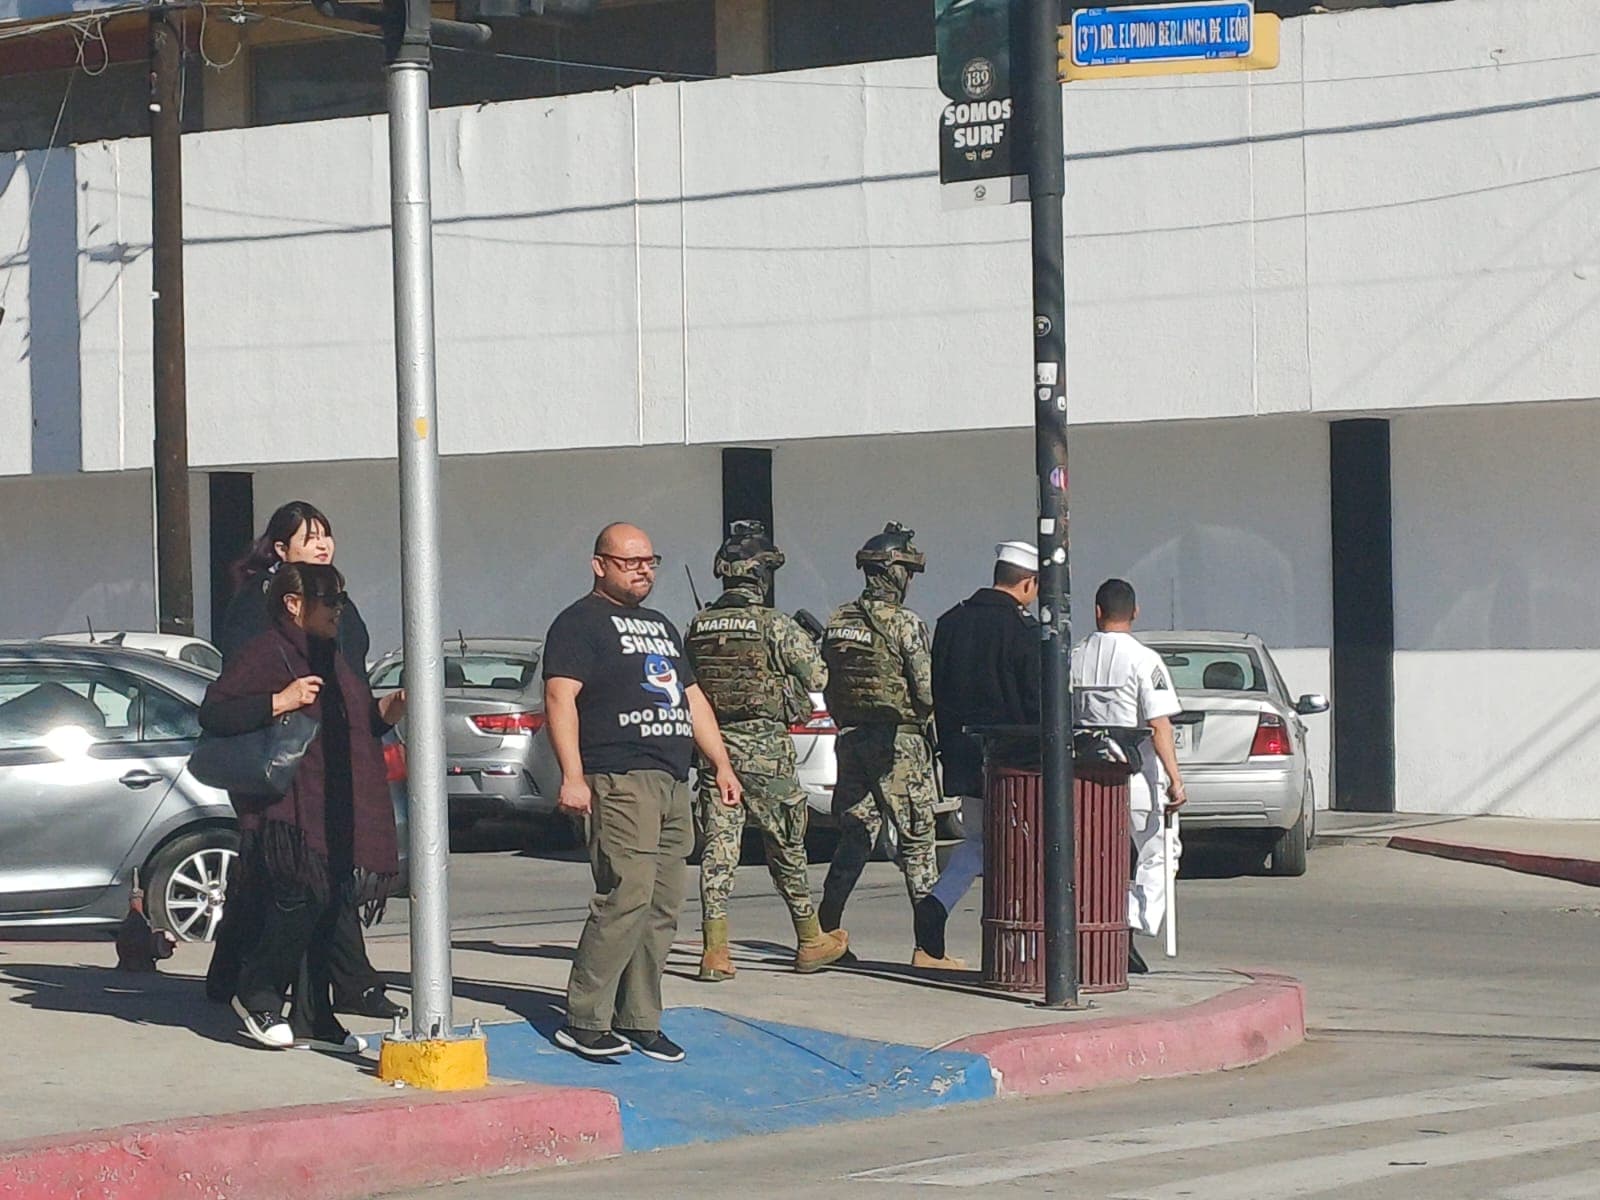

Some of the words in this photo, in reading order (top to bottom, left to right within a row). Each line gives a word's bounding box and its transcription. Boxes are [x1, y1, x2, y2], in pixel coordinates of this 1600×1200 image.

[1101, 24, 1117, 49] DR.
[1119, 22, 1155, 48] ELPIDIO
[1159, 18, 1206, 46] BERLANGA
[1209, 18, 1221, 43] DE
[1224, 9, 1248, 43] LEÓN
[944, 99, 1012, 125] SOMOS
[954, 124, 1005, 148] SURF
[610, 615, 668, 637] DADDY
[696, 618, 757, 632] MARINA
[620, 635, 680, 657] SHARK
[619, 709, 654, 726] DOO
[658, 708, 684, 720] DOO
[641, 723, 673, 737] DOO
